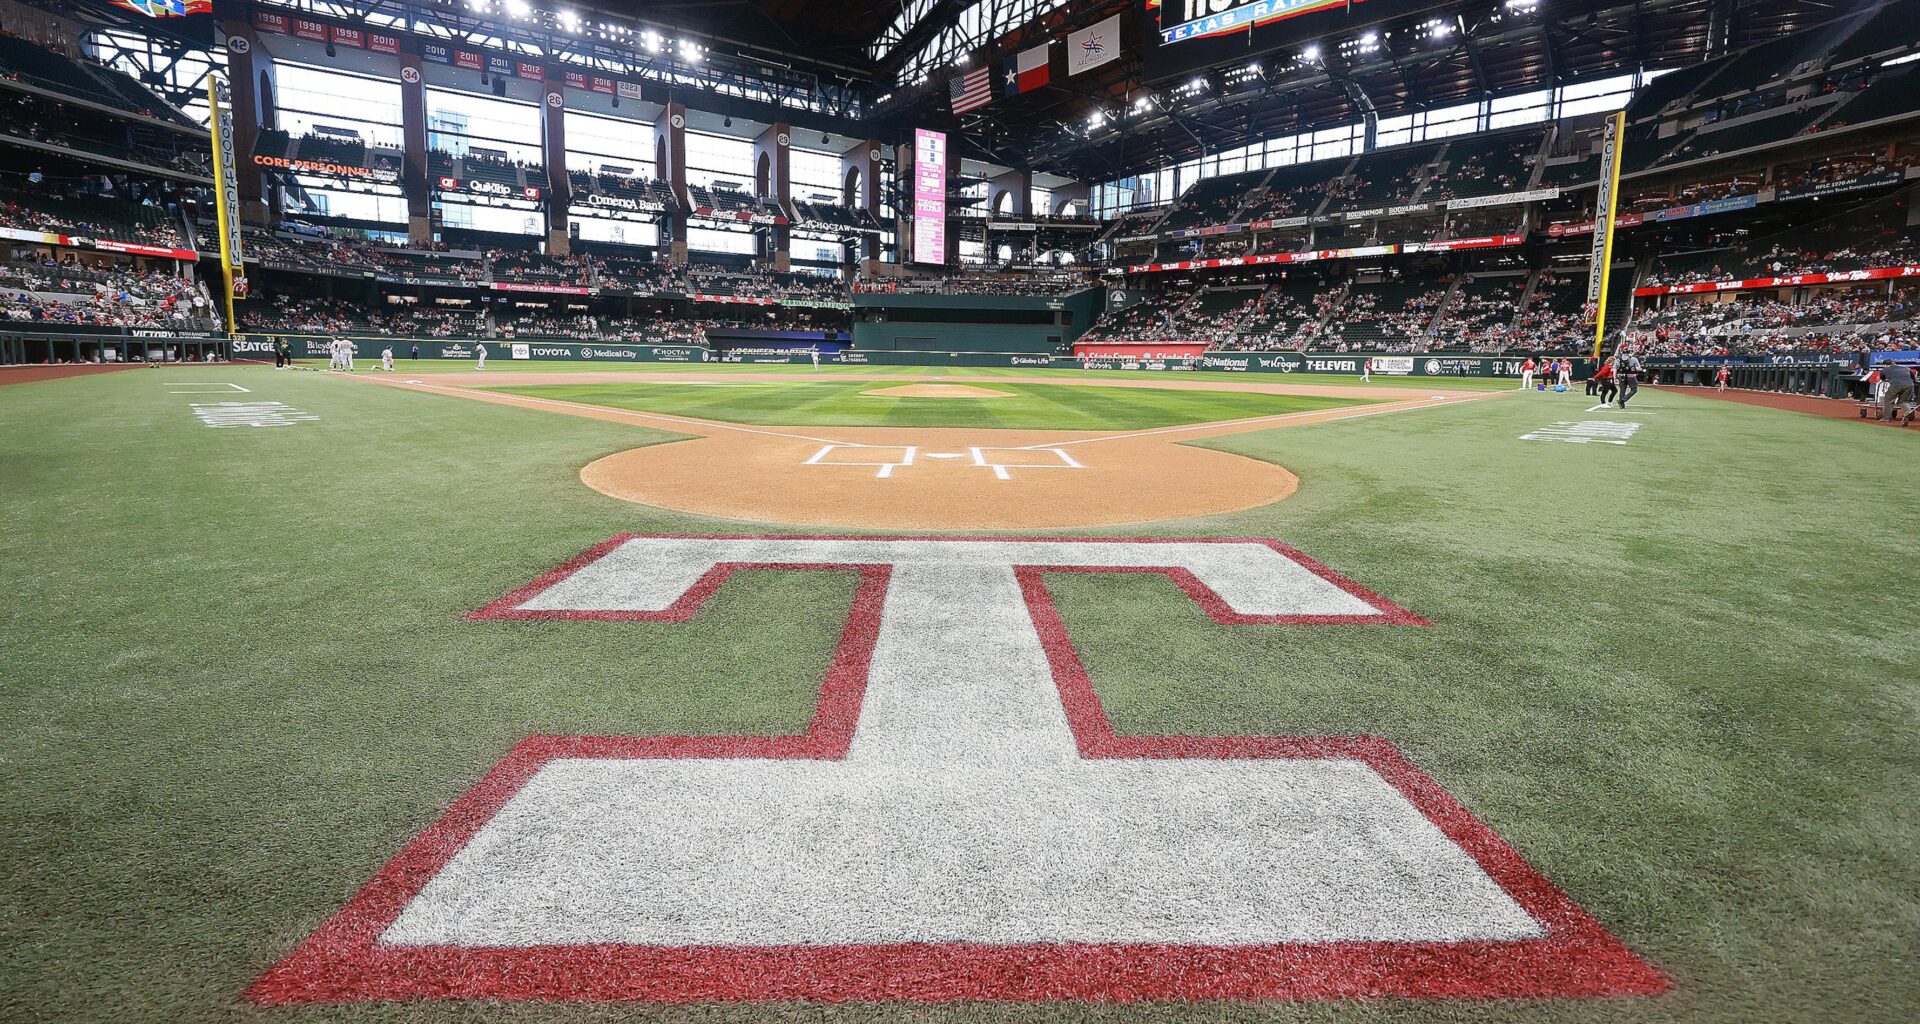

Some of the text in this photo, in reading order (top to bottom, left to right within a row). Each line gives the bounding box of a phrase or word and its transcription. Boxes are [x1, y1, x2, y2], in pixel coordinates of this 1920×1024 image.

[258, 13, 282, 25] 1996
[299, 20, 322, 32] 1998
[1161, 13, 1235, 43] TEXAS
[336, 27, 358, 39] 1999
[230, 39, 247, 51] 42
[373, 34, 395, 46] 2010
[425, 44, 446, 56] 2010
[460, 51, 478, 62] 2011
[1077, 52, 1109, 66] ARLINGTON
[491, 57, 508, 68] 2011
[522, 63, 540, 73] 2012
[404, 70, 417, 80] 34
[565, 71, 583, 82] 2015
[594, 77, 611, 87] 2016
[620, 82, 638, 92] 2023
[548, 96, 561, 105] 26
[675, 117, 681, 125] 7
[221, 114, 233, 164] ROOT
[254, 155, 290, 168] CORE
[294, 160, 373, 177] PERSONNEL
[441, 178, 454, 188] QT
[1599, 144, 1613, 215] CHIKIN
[469, 180, 512, 196] QuikTrip
[525, 187, 538, 198] QT
[639, 199, 665, 211] Bank
[1388, 203, 1429, 214] BODYARMOR
[1346, 208, 1384, 217] BODYARMOR
[226, 189, 241, 262] CHIKIN
[811, 220, 851, 231] CHOCTAW
[813, 301, 850, 309] STAFFING
[232, 341, 276, 352] SEATGE
[532, 348, 571, 356] TOYOTA
[593, 349, 637, 359] Medical City
[1212, 358, 1248, 367] National
[1271, 356, 1300, 373] Kroger
[1374, 359, 1384, 369] T
[1493, 361, 1503, 375] T
[250, 534, 1669, 1003] T
